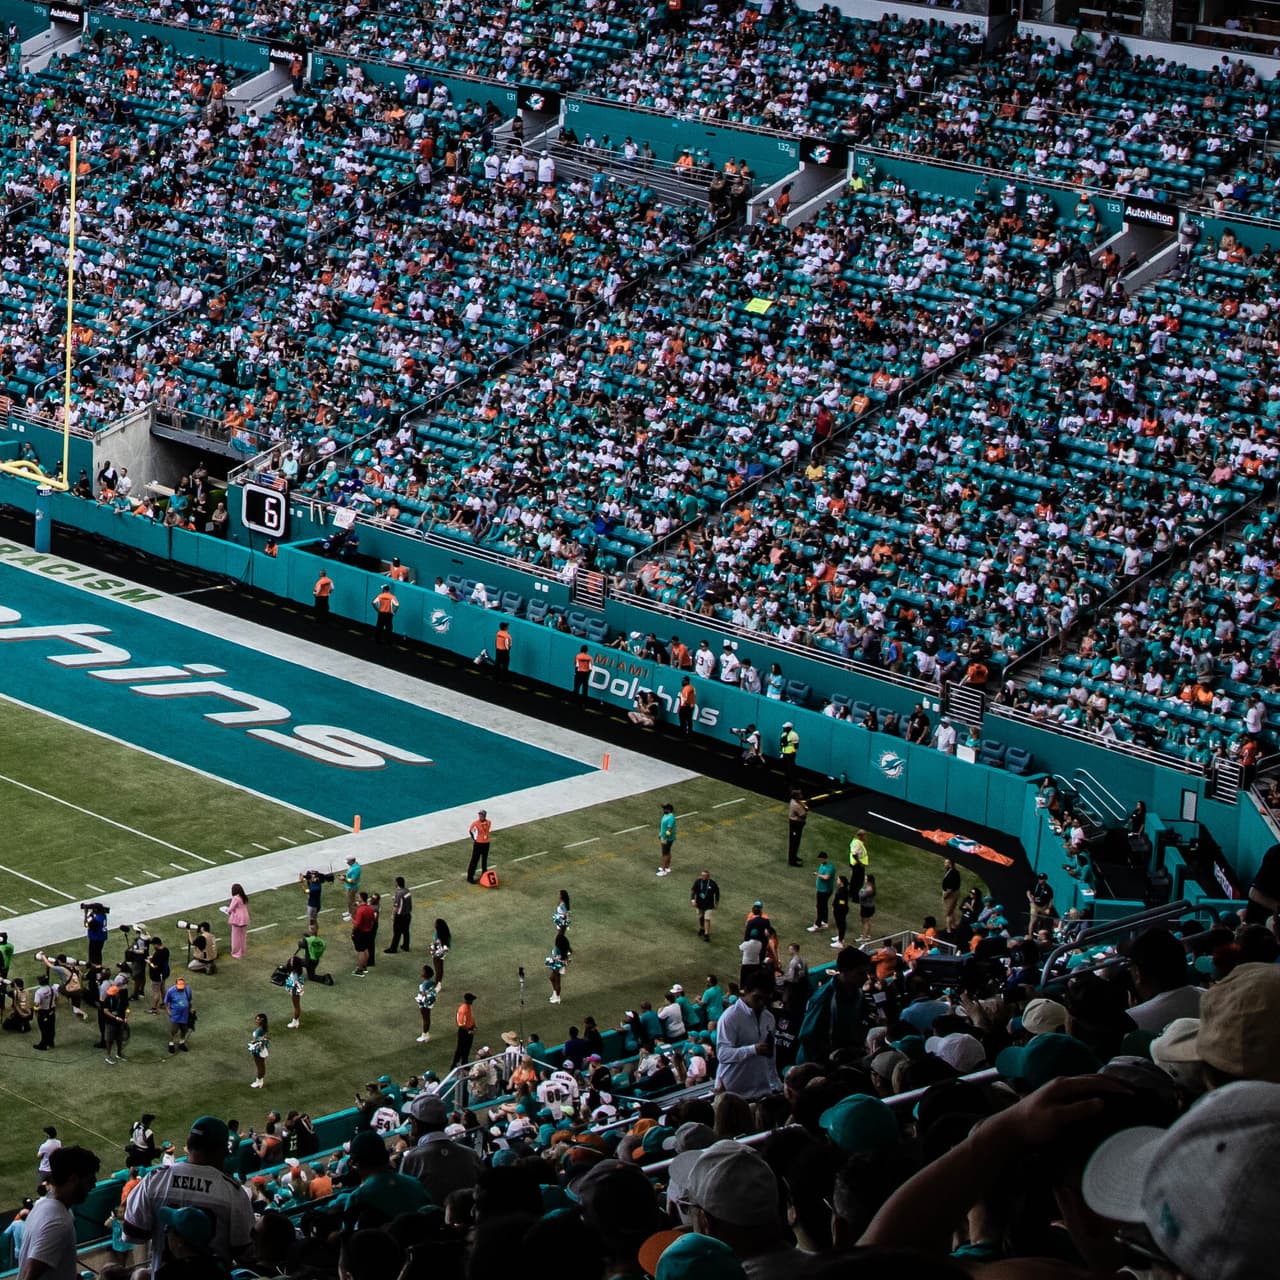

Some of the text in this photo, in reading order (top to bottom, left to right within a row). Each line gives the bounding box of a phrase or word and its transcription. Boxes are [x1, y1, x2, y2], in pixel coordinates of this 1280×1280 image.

[778, 143, 790, 152] 132
[1107, 203, 1121, 213] 133
[1125, 206, 1174, 225] AutoNation
[264, 497, 279, 529] 6
[595, 653, 651, 680] MIAMI
[171, 1174, 213, 1195] KELLY
